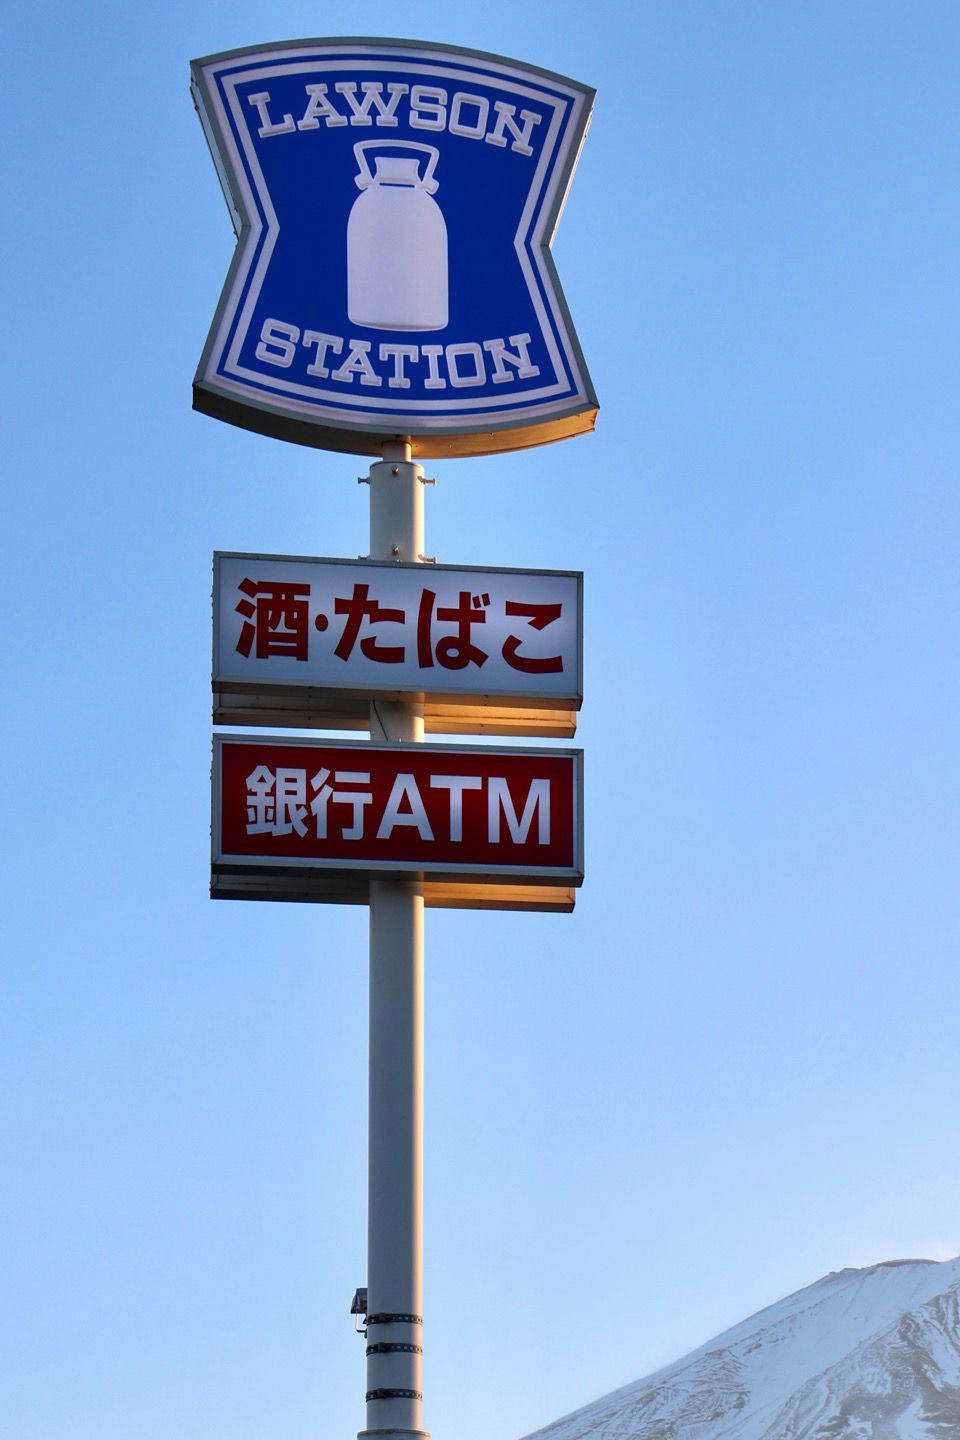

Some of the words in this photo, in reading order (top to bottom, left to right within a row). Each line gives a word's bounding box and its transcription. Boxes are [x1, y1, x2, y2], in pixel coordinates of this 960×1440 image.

[247, 81, 542, 157] LAWSON
[255, 317, 541, 390] STATION
[234, 577, 564, 674] 酒・たばこ
[245, 765, 551, 845] 銀行ATM
